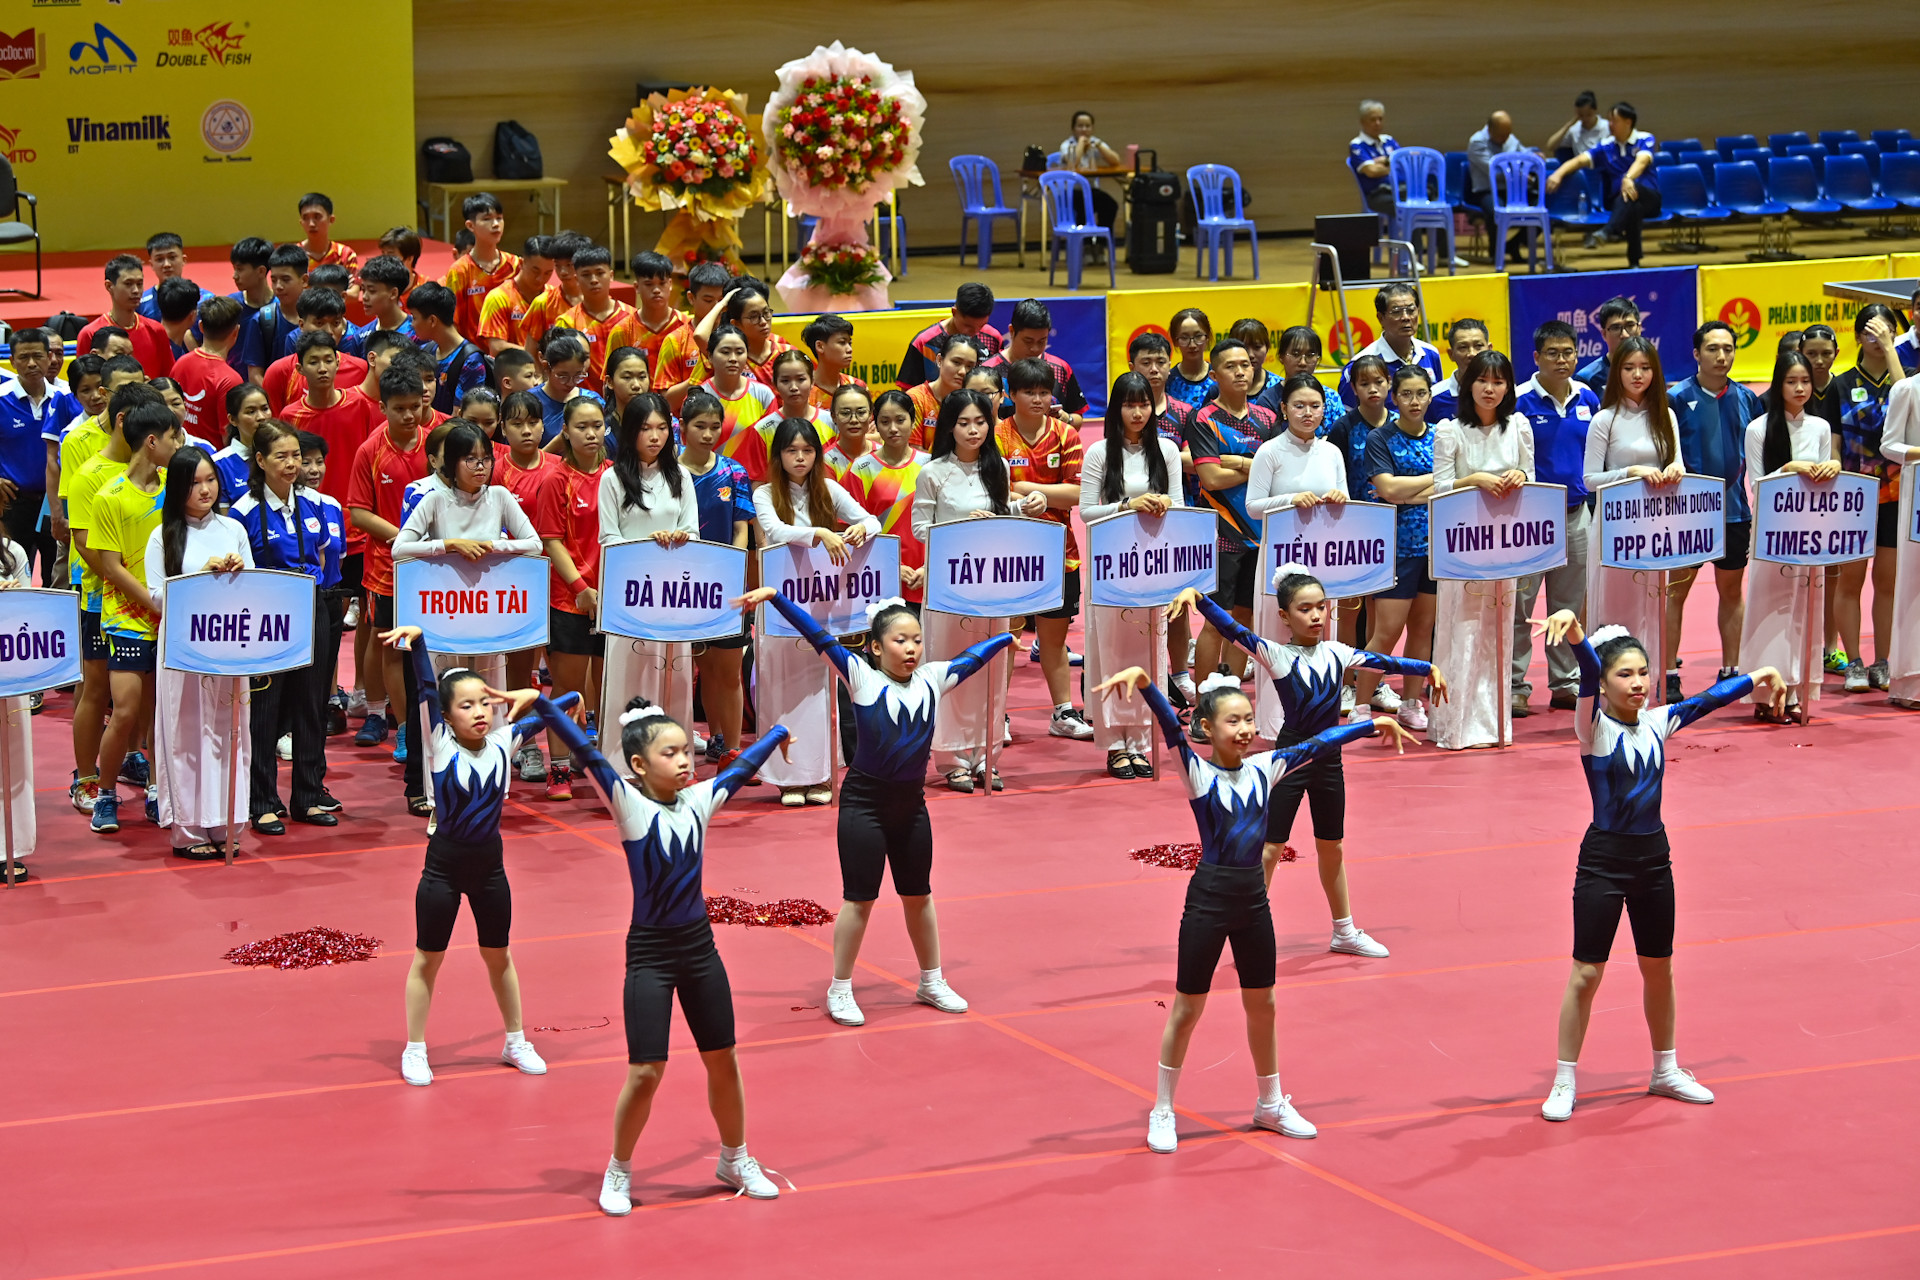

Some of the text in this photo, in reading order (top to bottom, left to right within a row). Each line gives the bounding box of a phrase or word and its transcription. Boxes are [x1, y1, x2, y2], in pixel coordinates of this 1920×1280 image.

[70, 64, 138, 75] MOFIT
[156, 52, 252, 67] DOUBLE FISH
[67, 115, 171, 142] Vinamilk
[68, 145, 79, 154] EST
[1800, 301, 1822, 323] BÓN
[872, 360, 897, 384] BÓN
[1604, 491, 1722, 524] CLB ĐẠI HỌC BÌNH DƯƠNG
[1774, 487, 1864, 517] CÂU LẠC BỘ
[1274, 533, 1385, 568] TIỀN GIANG
[1445, 520, 1555, 553] VĨNH LONG
[1613, 527, 1714, 562] PPP CÀ MAU
[1765, 530, 1868, 556] TIMES CITY
[948, 552, 1044, 585] TÂY NINH
[1094, 542, 1213, 581] TP. HỒ CHÍ MINH
[625, 571, 723, 610] ĐÀ NẴNG
[846, 566, 881, 604] ĐỘI
[418, 585, 528, 620] TRỌNG TÀI
[0, 622, 65, 661] ĐỒNG
[190, 608, 290, 648] NGHỆ AN
